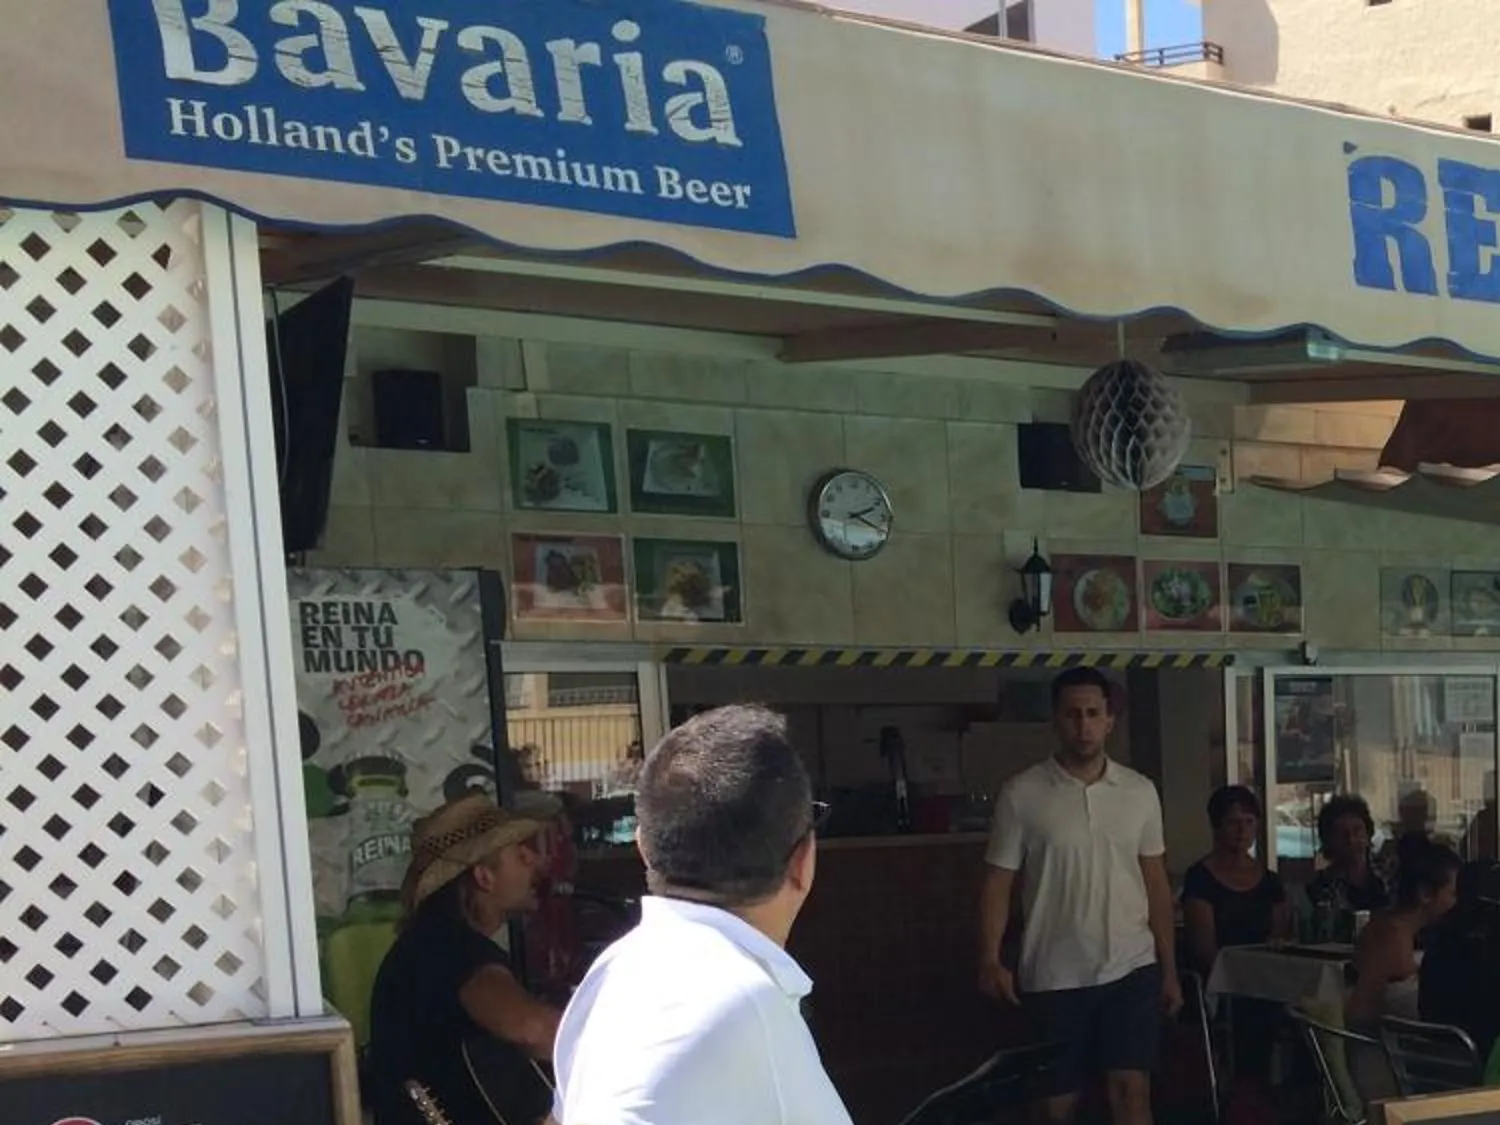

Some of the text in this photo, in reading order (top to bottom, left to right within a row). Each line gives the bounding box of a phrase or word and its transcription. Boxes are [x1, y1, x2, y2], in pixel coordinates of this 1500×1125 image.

[153, 0, 743, 148] Bavaria
[432, 133, 644, 194] Premium
[658, 164, 751, 210] Beer
[299, 601, 399, 625] REINA
[301, 626, 393, 648] EN TU
[304, 649, 425, 674] MUNDO
[353, 835, 412, 866] REINA
